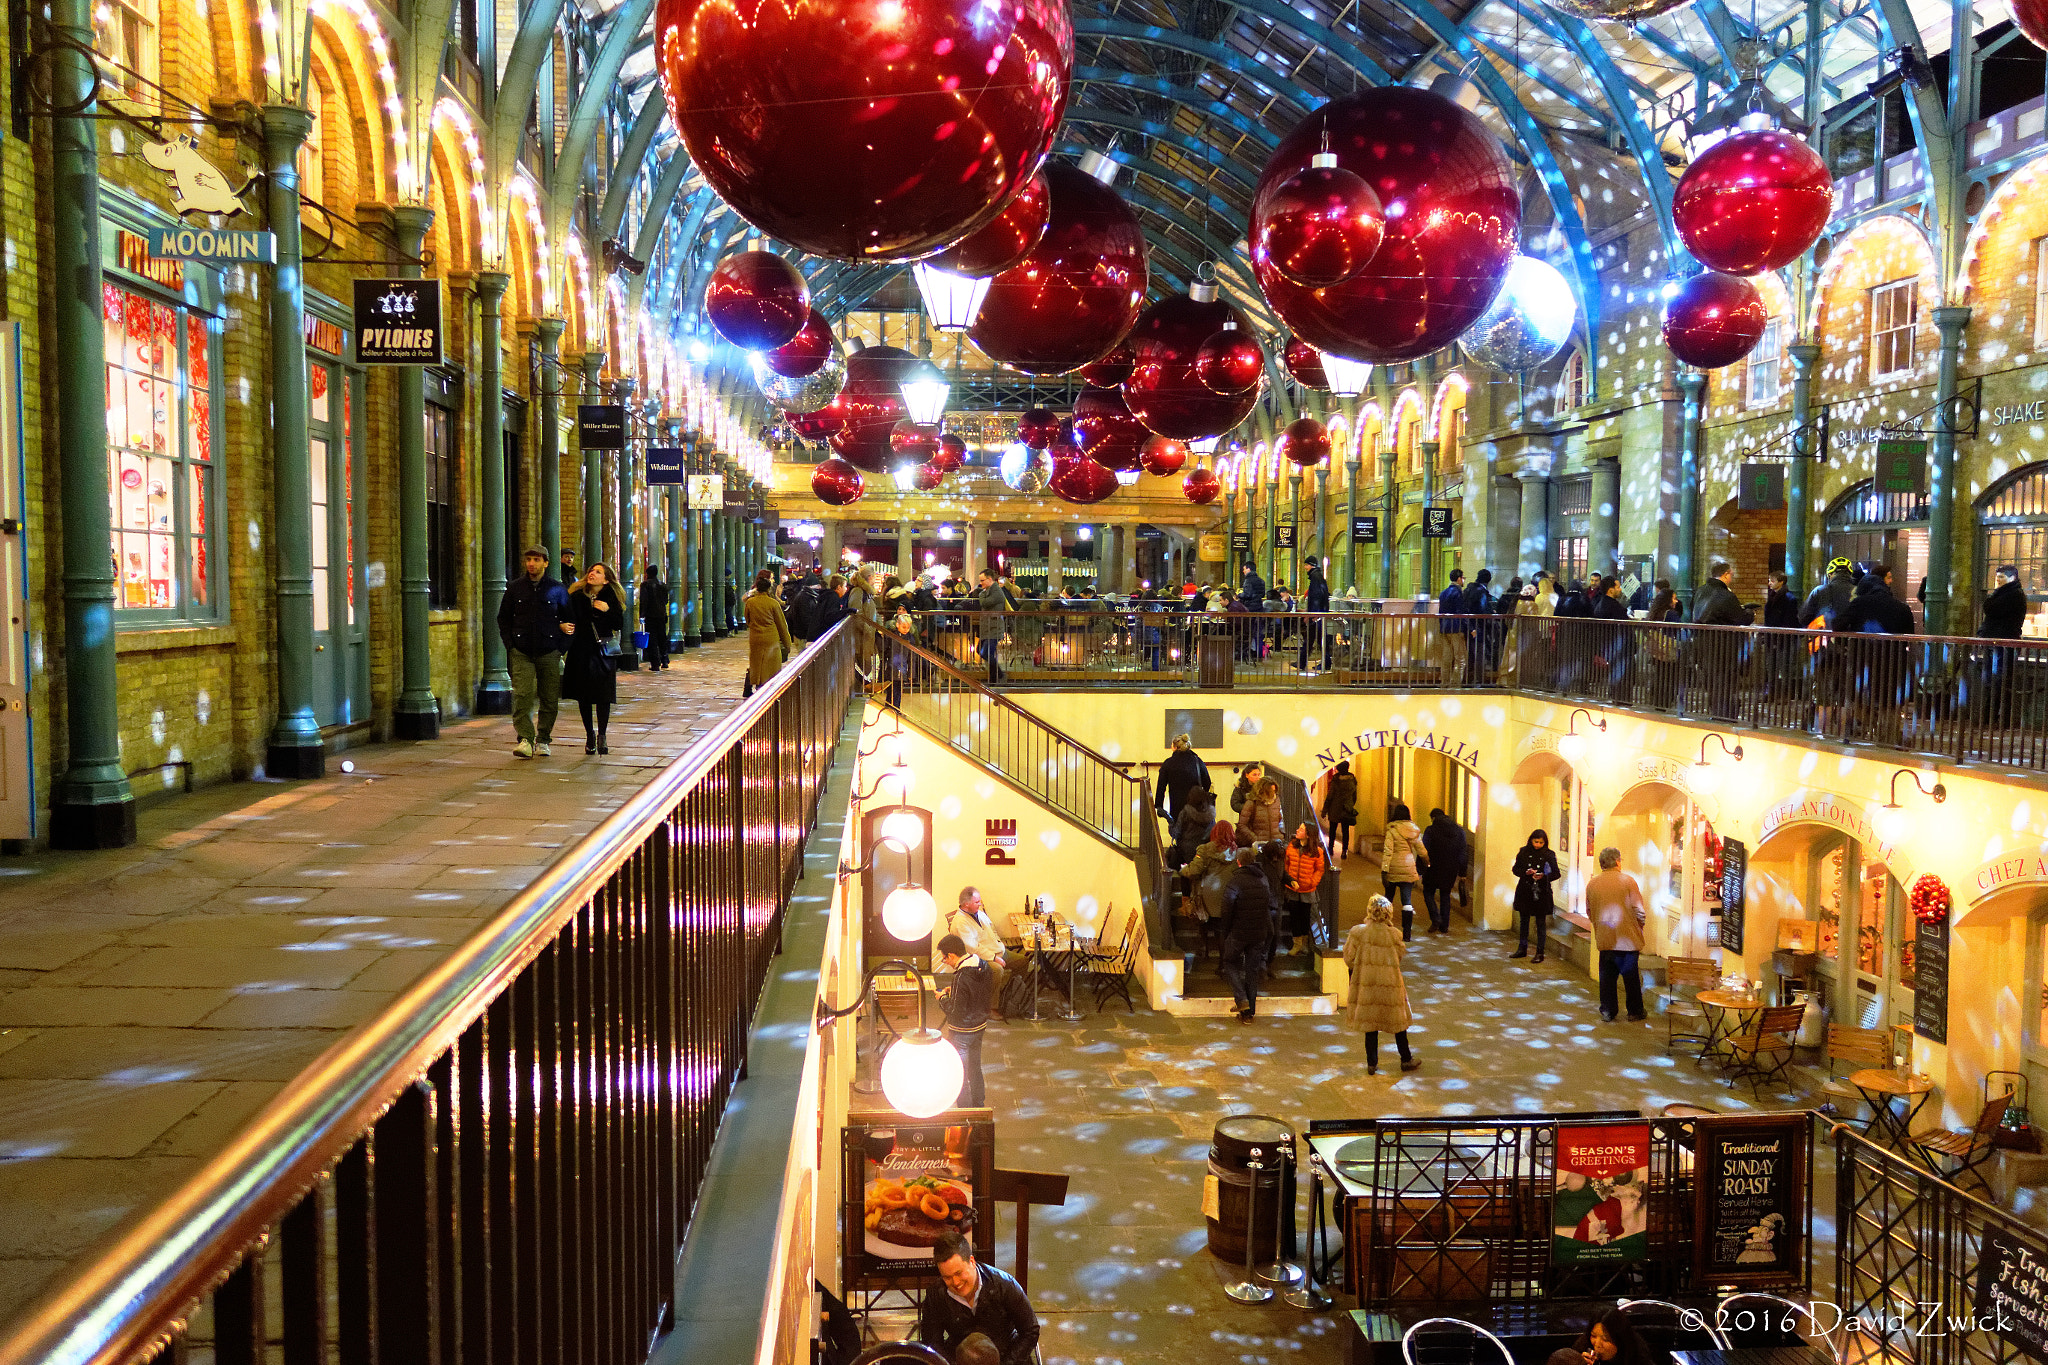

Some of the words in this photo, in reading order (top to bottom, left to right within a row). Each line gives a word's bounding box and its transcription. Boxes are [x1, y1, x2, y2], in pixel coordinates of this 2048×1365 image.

[161, 230, 259, 258] MOOMIN
[121, 230, 185, 288] PYLONES
[303, 313, 343, 356] PYLONES
[361, 328, 434, 349] PYLONES
[417, 349, 433, 357] Paris
[1993, 400, 2046, 427] SHAKE
[1838, 425, 1877, 448] SHAKE
[1880, 443, 1905, 454] PICK
[1909, 443, 1925, 455] UP
[650, 463, 680, 471] Whittard
[1886, 479, 1914, 490] HERE
[1315, 729, 1480, 770] NAUTICALIA
[1531, 735, 1547, 751] Sass
[1637, 762, 1659, 779] Sass
[1660, 760, 1668, 779] &
[1763, 803, 1796, 831] CHEZ
[1977, 858, 2027, 890] CHEZ
[1571, 1145, 1636, 1156] SEASON'S
[1721, 1139, 1781, 1155] Traditional
[1570, 1155, 1636, 1166] GREETINGS
[1723, 1158, 1779, 1176] SUNDAY
[1722, 1176, 1771, 1196] ROAST
[1718, 1197, 1750, 1208] Served
[1750, 1196, 1774, 1207] Here
[1998, 1259, 2044, 1305] Fish
[1989, 1282, 2038, 1324] Served
